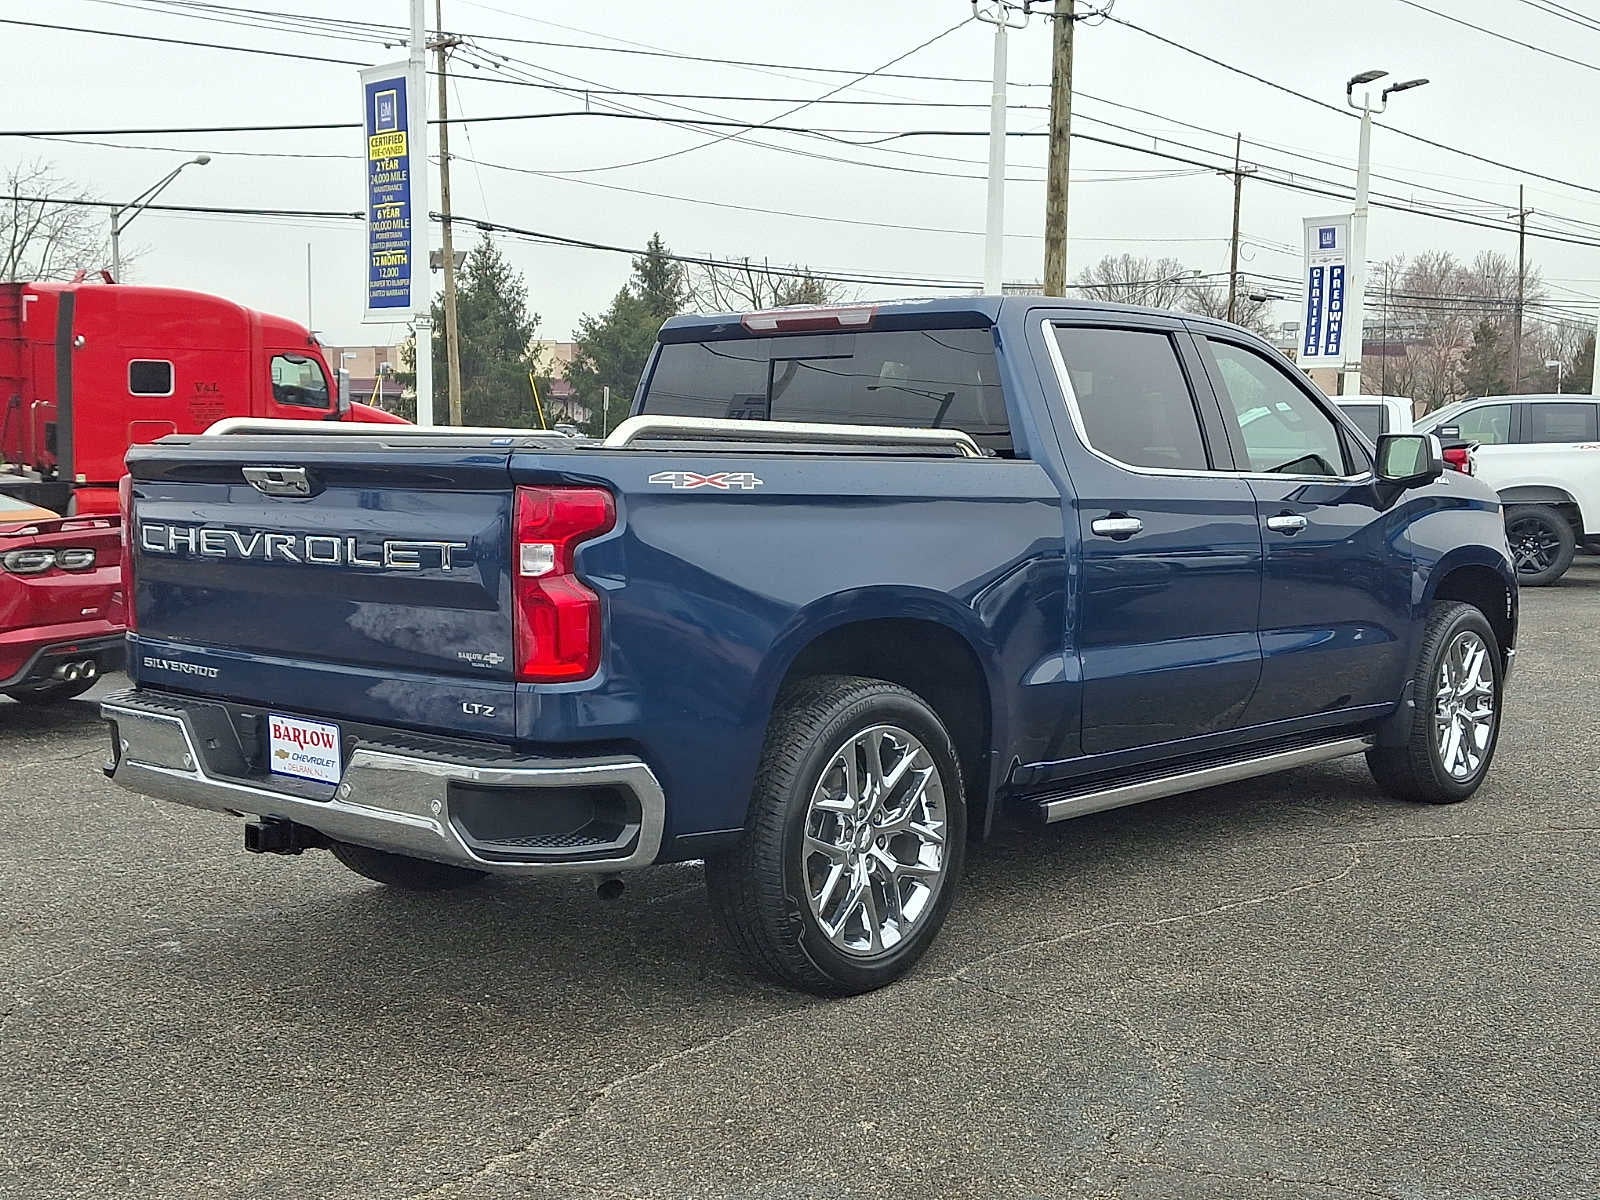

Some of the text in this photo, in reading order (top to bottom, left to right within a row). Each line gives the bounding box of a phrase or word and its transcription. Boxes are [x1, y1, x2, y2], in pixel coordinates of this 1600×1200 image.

[371, 134, 404, 148] CERTIFIED
[381, 159, 399, 171] YEAR
[391, 170, 407, 182] MILE
[377, 207, 400, 219] 6 YEAR
[392, 218, 410, 230] MILE
[373, 254, 407, 267] 12 MONTH
[1307, 268, 1321, 354] CERTIFIED
[1327, 267, 1342, 353] PREOWNED
[141, 523, 468, 571] CHEVROLET
[143, 657, 220, 679] SILVERADO
[462, 702, 496, 717] LTZ
[273, 723, 335, 750] BARLOW
[291, 752, 336, 768] CHEVROLET
